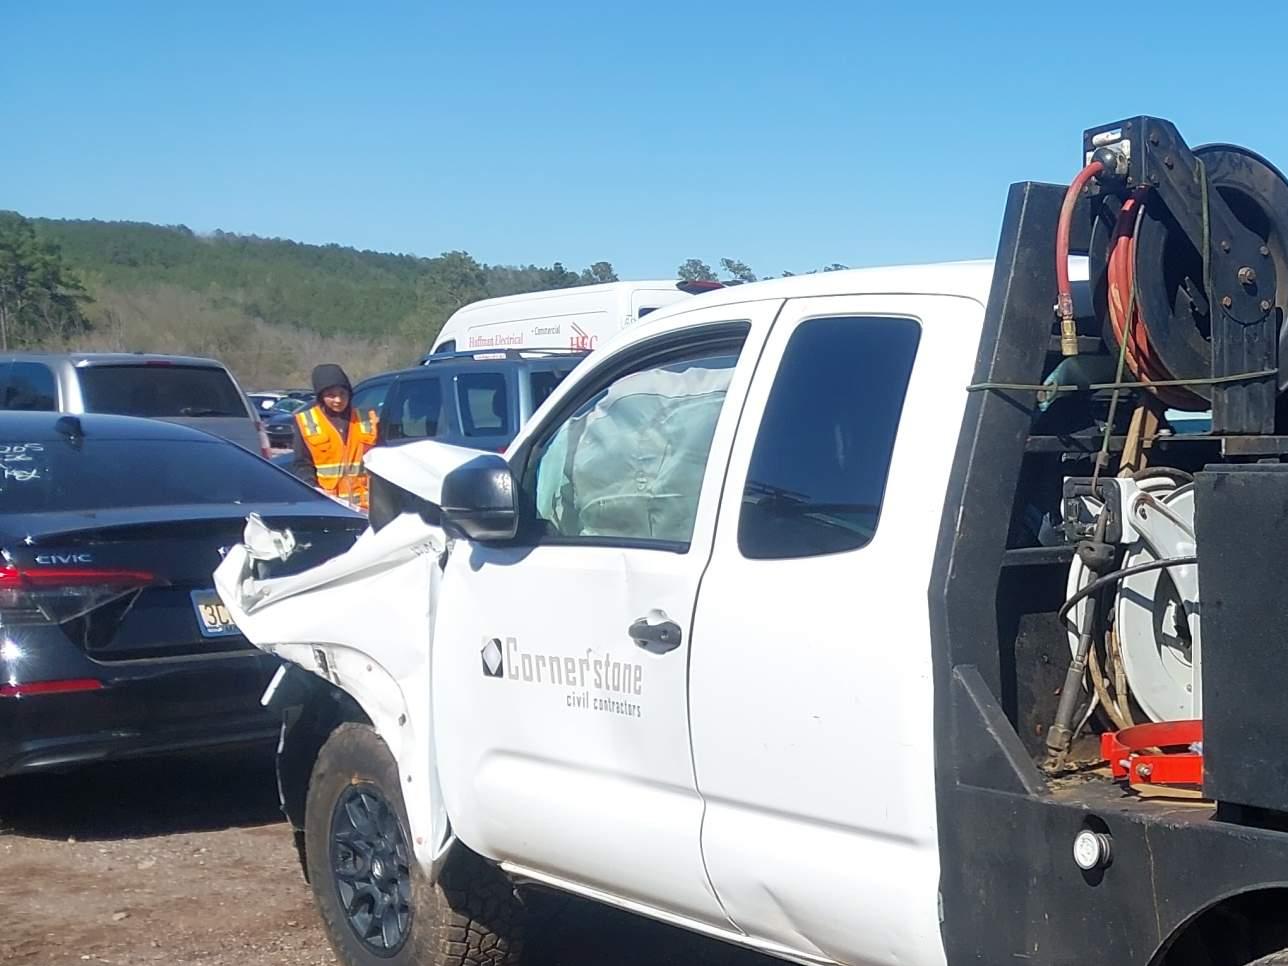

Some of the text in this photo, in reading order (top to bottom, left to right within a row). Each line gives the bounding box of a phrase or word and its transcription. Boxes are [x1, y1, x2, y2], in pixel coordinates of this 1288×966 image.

[495, 332, 524, 346] Electrical
[35, 554, 93, 564] CIVIC
[566, 692, 641, 718] civil contractors
